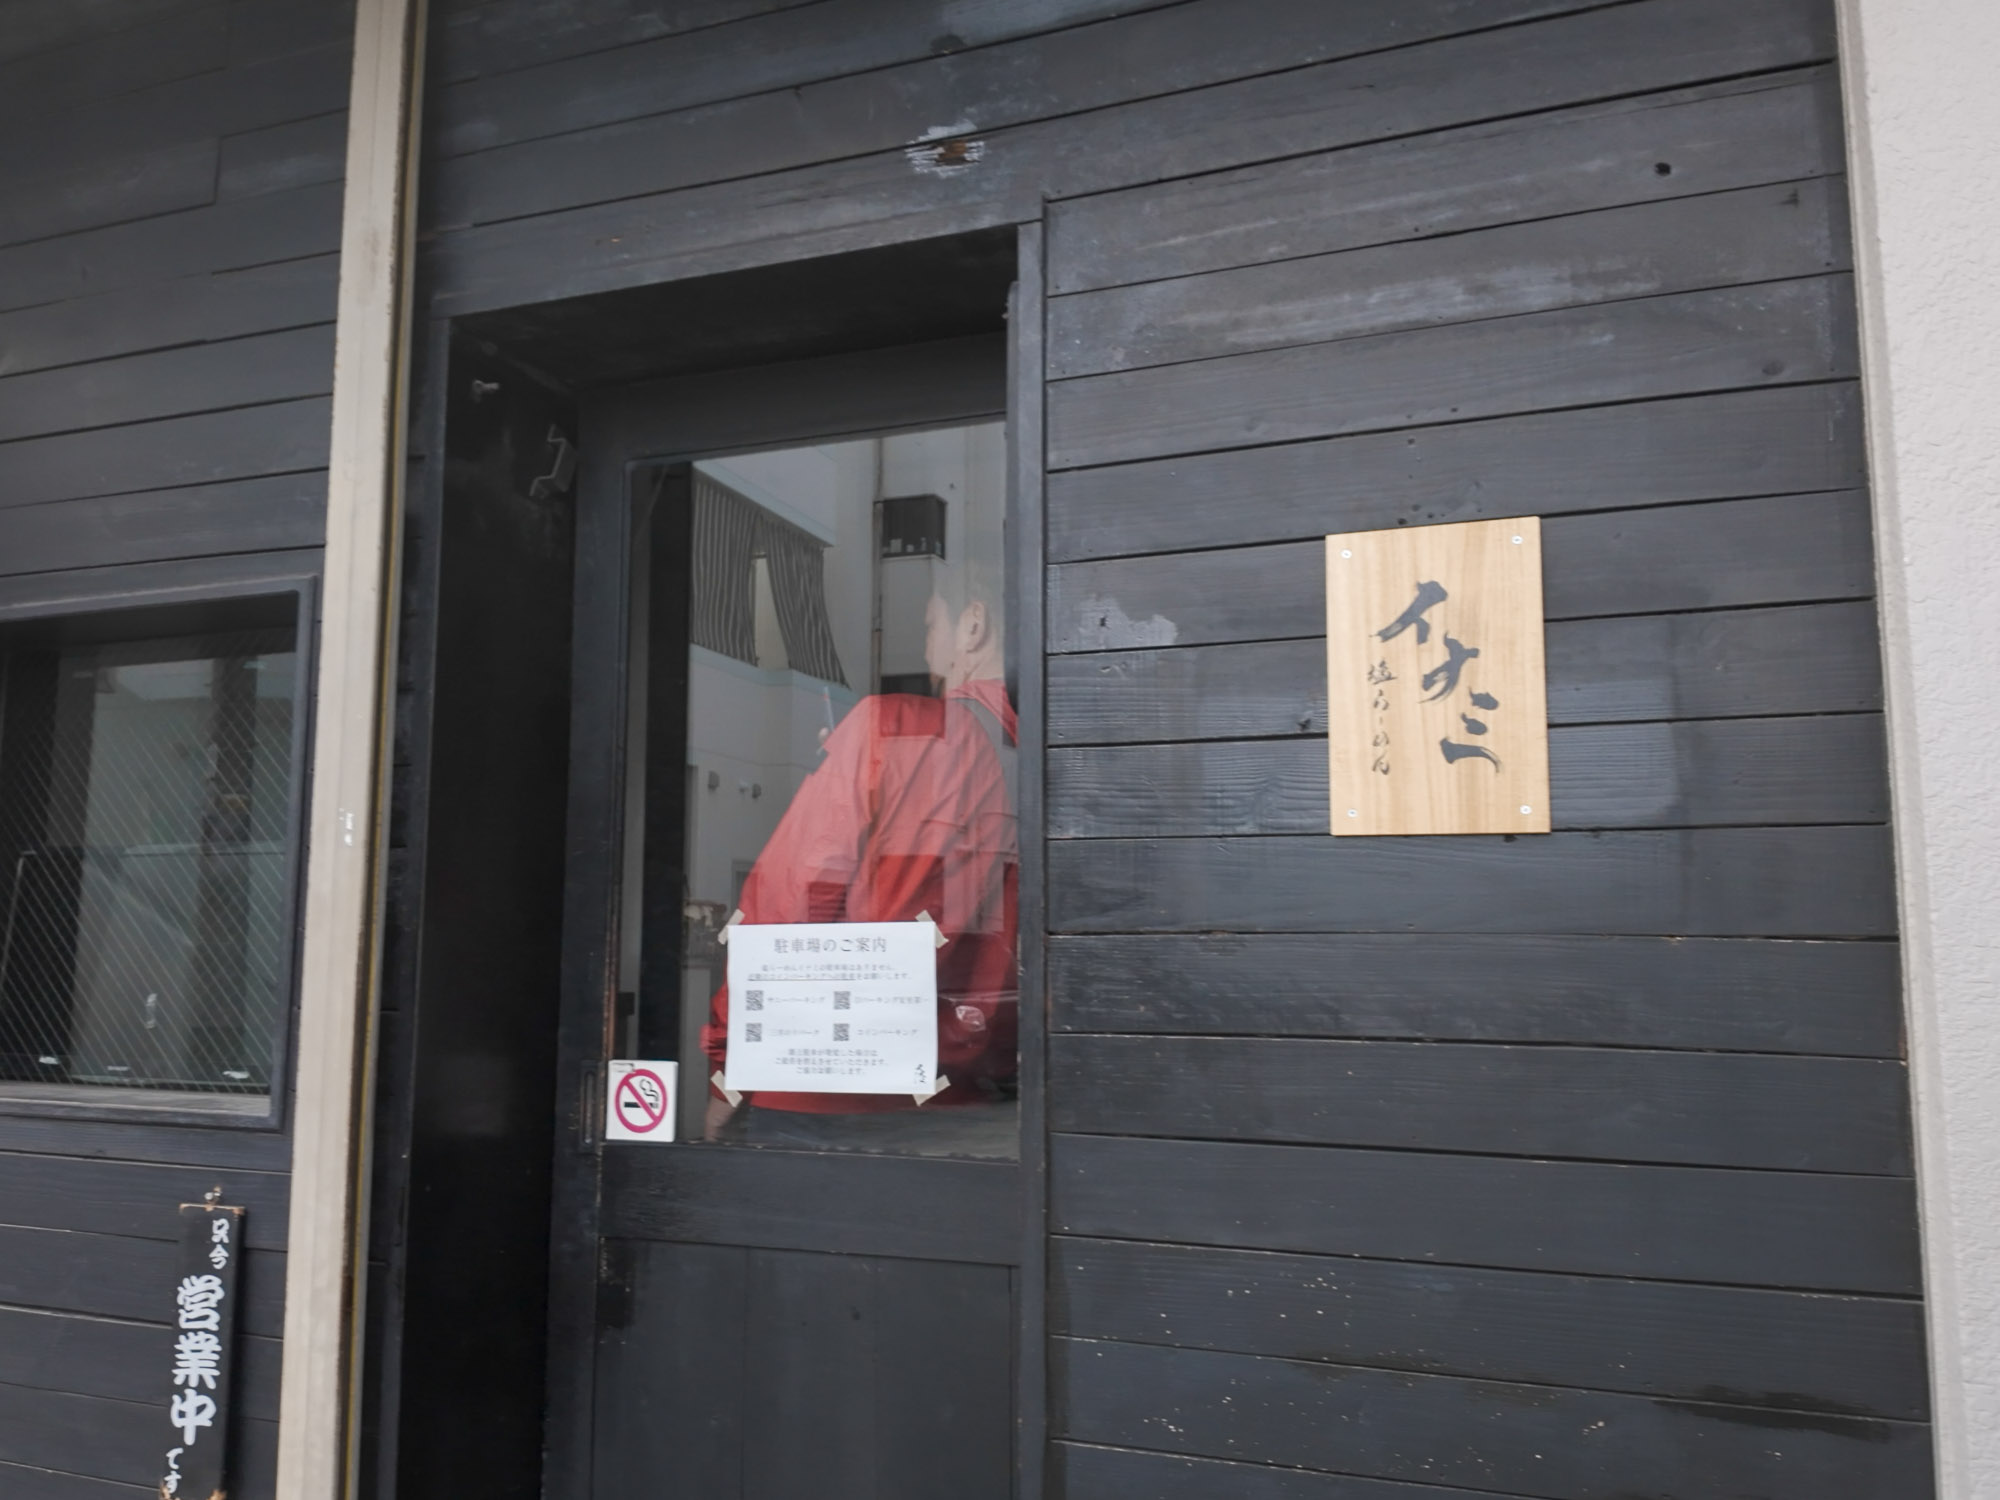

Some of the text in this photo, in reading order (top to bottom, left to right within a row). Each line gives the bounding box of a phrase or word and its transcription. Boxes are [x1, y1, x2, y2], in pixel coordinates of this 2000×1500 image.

[1367, 657, 1398, 776] 塩らーめん
[1369, 580, 1503, 774] イナミ
[774, 937, 887, 954] 駐車場のご案内
